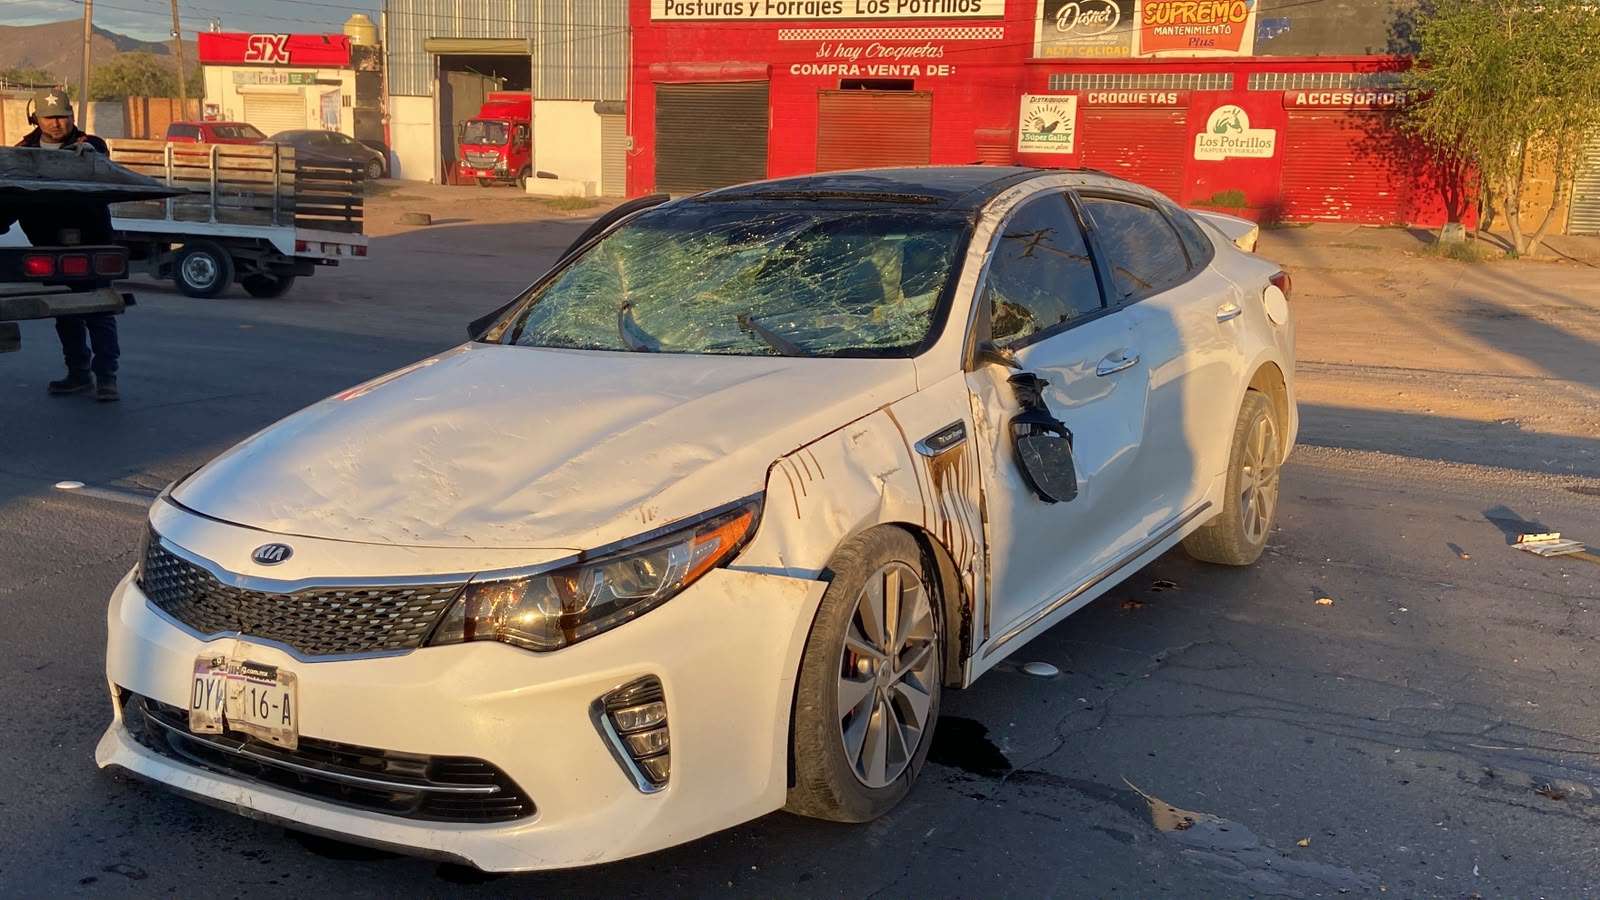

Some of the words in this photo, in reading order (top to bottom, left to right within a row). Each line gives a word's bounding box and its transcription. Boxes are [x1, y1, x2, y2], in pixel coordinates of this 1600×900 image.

[664, 0, 744, 16] Pasturas
[749, 1, 760, 17] y
[765, 0, 843, 17] Forrajes
[855, 0, 890, 15] Los
[897, 0, 982, 14] Potrillos
[1143, 0, 1247, 24] SUPREMO
[1153, 24, 1232, 36] MANTENIMIENTO
[816, 42, 832, 58] Si
[833, 43, 863, 63] hay
[865, 42, 944, 61] Croquetas
[1045, 47, 1074, 56] ALTA
[1078, 46, 1129, 56] CALIDAD
[790, 64, 921, 76] COMPRA-VENTA
[926, 64, 956, 76] DE:
[1088, 92, 1177, 105] CROQUETAS
[1199, 136, 1218, 147] Los
[1220, 136, 1272, 148] Potrillos
